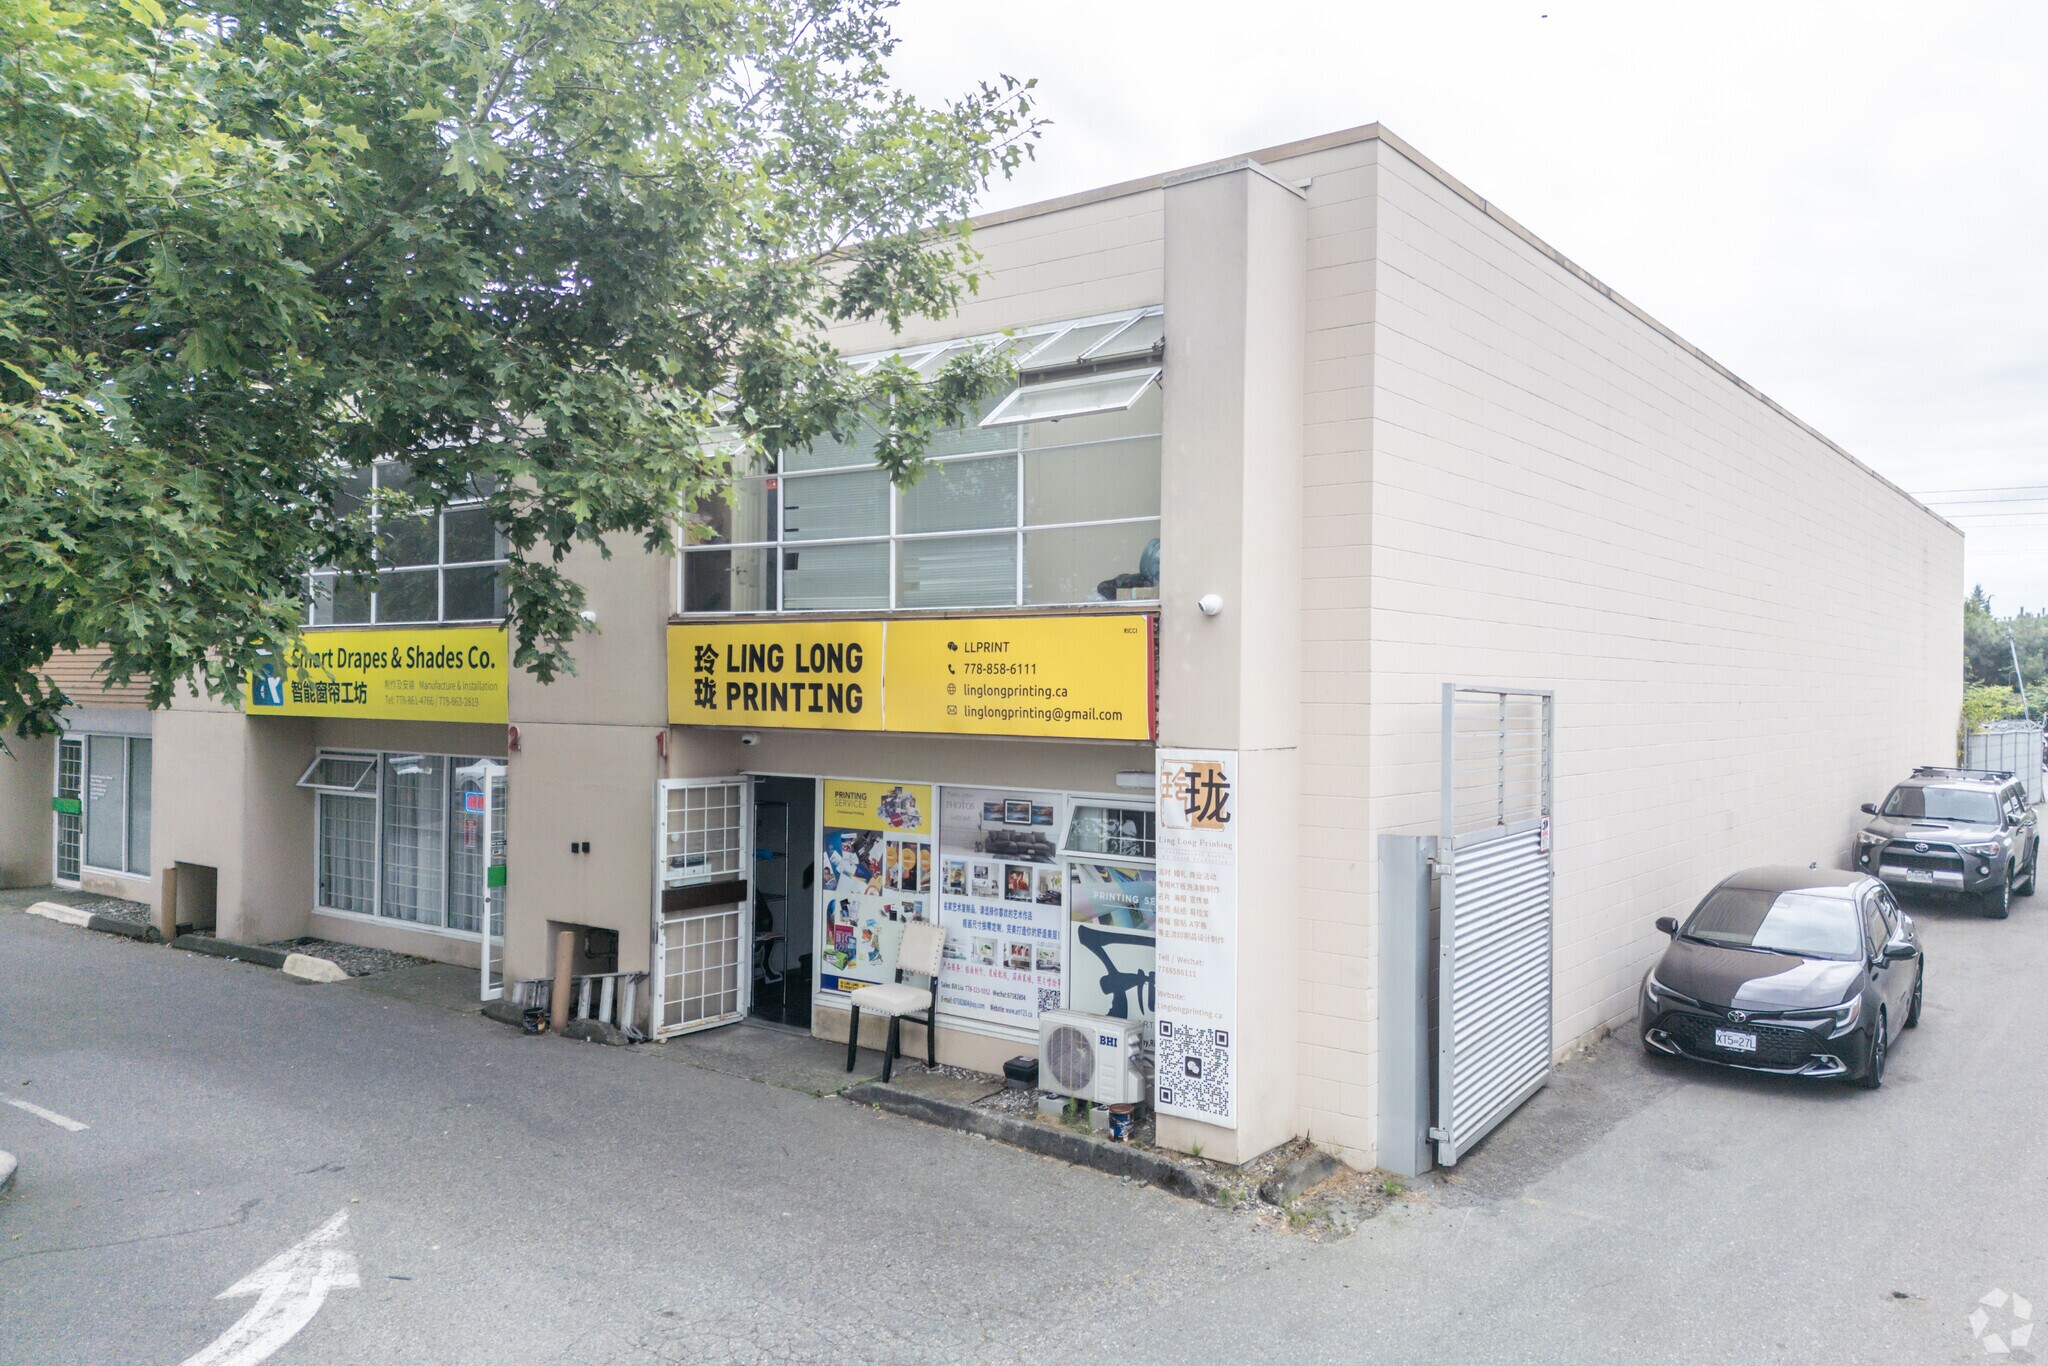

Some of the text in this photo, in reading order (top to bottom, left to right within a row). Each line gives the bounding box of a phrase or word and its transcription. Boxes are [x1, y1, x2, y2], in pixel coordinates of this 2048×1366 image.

[964, 641, 1010, 653] LLPRINT
[338, 647, 387, 674] Drapes
[391, 646, 402, 669] &
[406, 645, 463, 669] Shades
[468, 645, 496, 670] Co.
[726, 643, 863, 673] LING LONG
[964, 663, 1037, 675] 778-858-6111
[419, 680, 456, 692] Manufacture
[456, 681, 462, 691] &
[462, 681, 498, 692] Installation
[963, 684, 1068, 699] linglongprinting.ca
[726, 682, 863, 714] PRINTING
[964, 706, 1123, 722] linglongprinting@gmail.com
[509, 726, 520, 751] 2
[834, 791, 867, 800] PRINTING
[834, 800, 867, 809] SERVICES
[945, 801, 975, 809] PHOTOS
[1158, 836, 1233, 850] Ling Long Printing
[1093, 891, 1139, 904] PRINTING
[1157, 1003, 1223, 1019] Linglongprinting.ca
[1100, 1035, 1118, 1048] BHI
